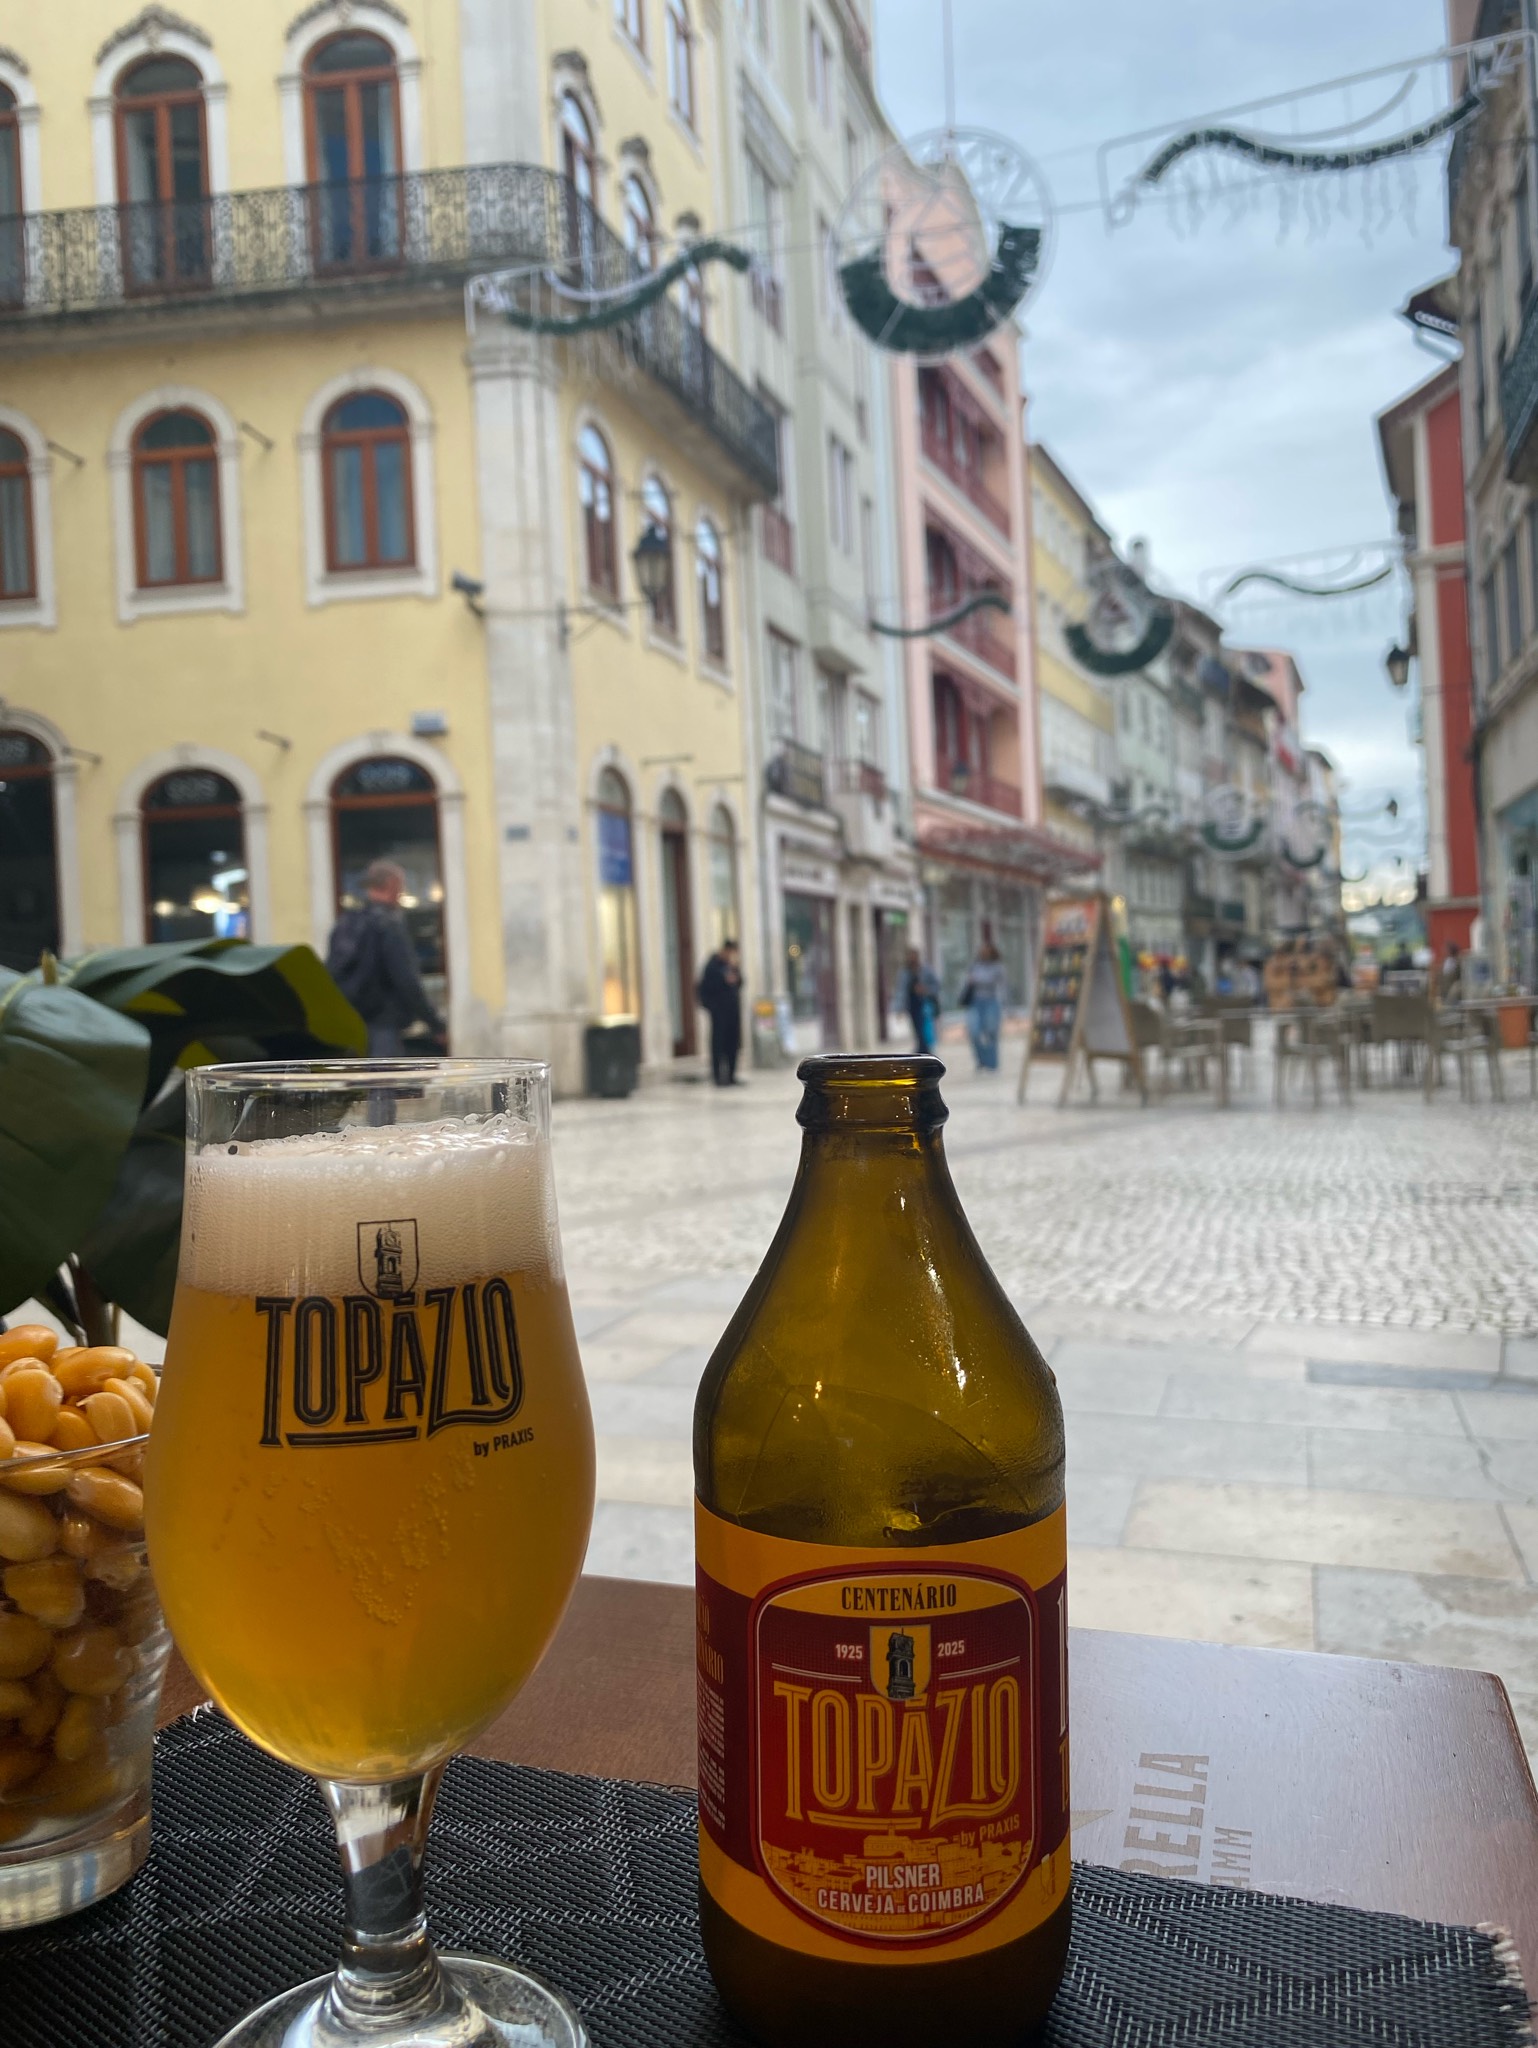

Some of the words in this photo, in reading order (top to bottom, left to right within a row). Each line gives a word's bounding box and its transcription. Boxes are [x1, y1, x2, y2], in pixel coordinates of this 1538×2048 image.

[473, 1441, 491, 1457] by
[493, 1427, 534, 1451] PRAXIS
[841, 1583, 957, 1611] CENTENÁRIO
[836, 1644, 863, 1659] 1925
[938, 1640, 965, 1657] 2025
[961, 1831, 975, 1847] by
[979, 1814, 1020, 1842] PRAXIS
[866, 1863, 940, 1889] PILSNER
[818, 1889, 895, 1914] CERVEJA
[908, 1883, 984, 1913] COIMBRA
